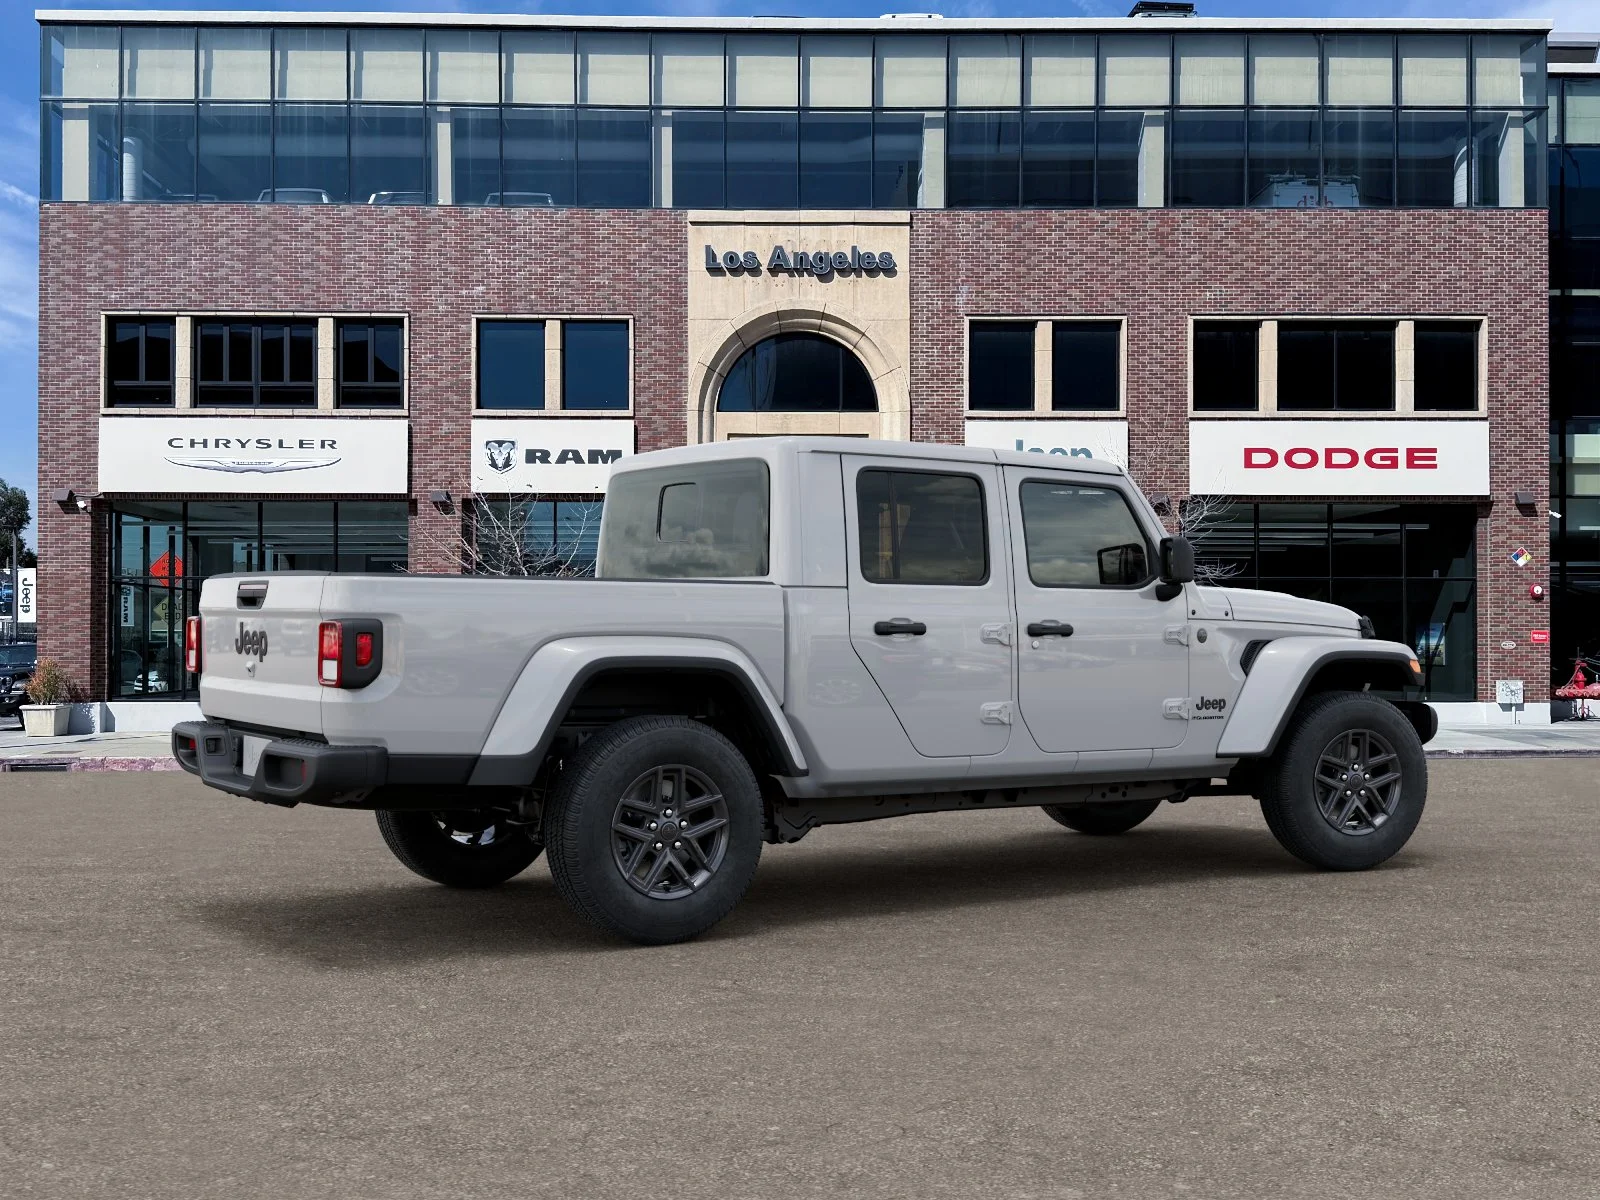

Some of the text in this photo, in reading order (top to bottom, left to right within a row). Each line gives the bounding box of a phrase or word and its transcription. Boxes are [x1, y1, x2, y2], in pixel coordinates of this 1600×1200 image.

[704, 244, 896, 275] Los Angeles
[167, 437, 338, 450] CHRYSLER
[524, 448, 623, 465] RAM
[1243, 447, 1438, 469] DODGE
[20, 577, 34, 614] Jeep
[235, 621, 268, 663] Jeep
[1196, 696, 1226, 712] Jeep
